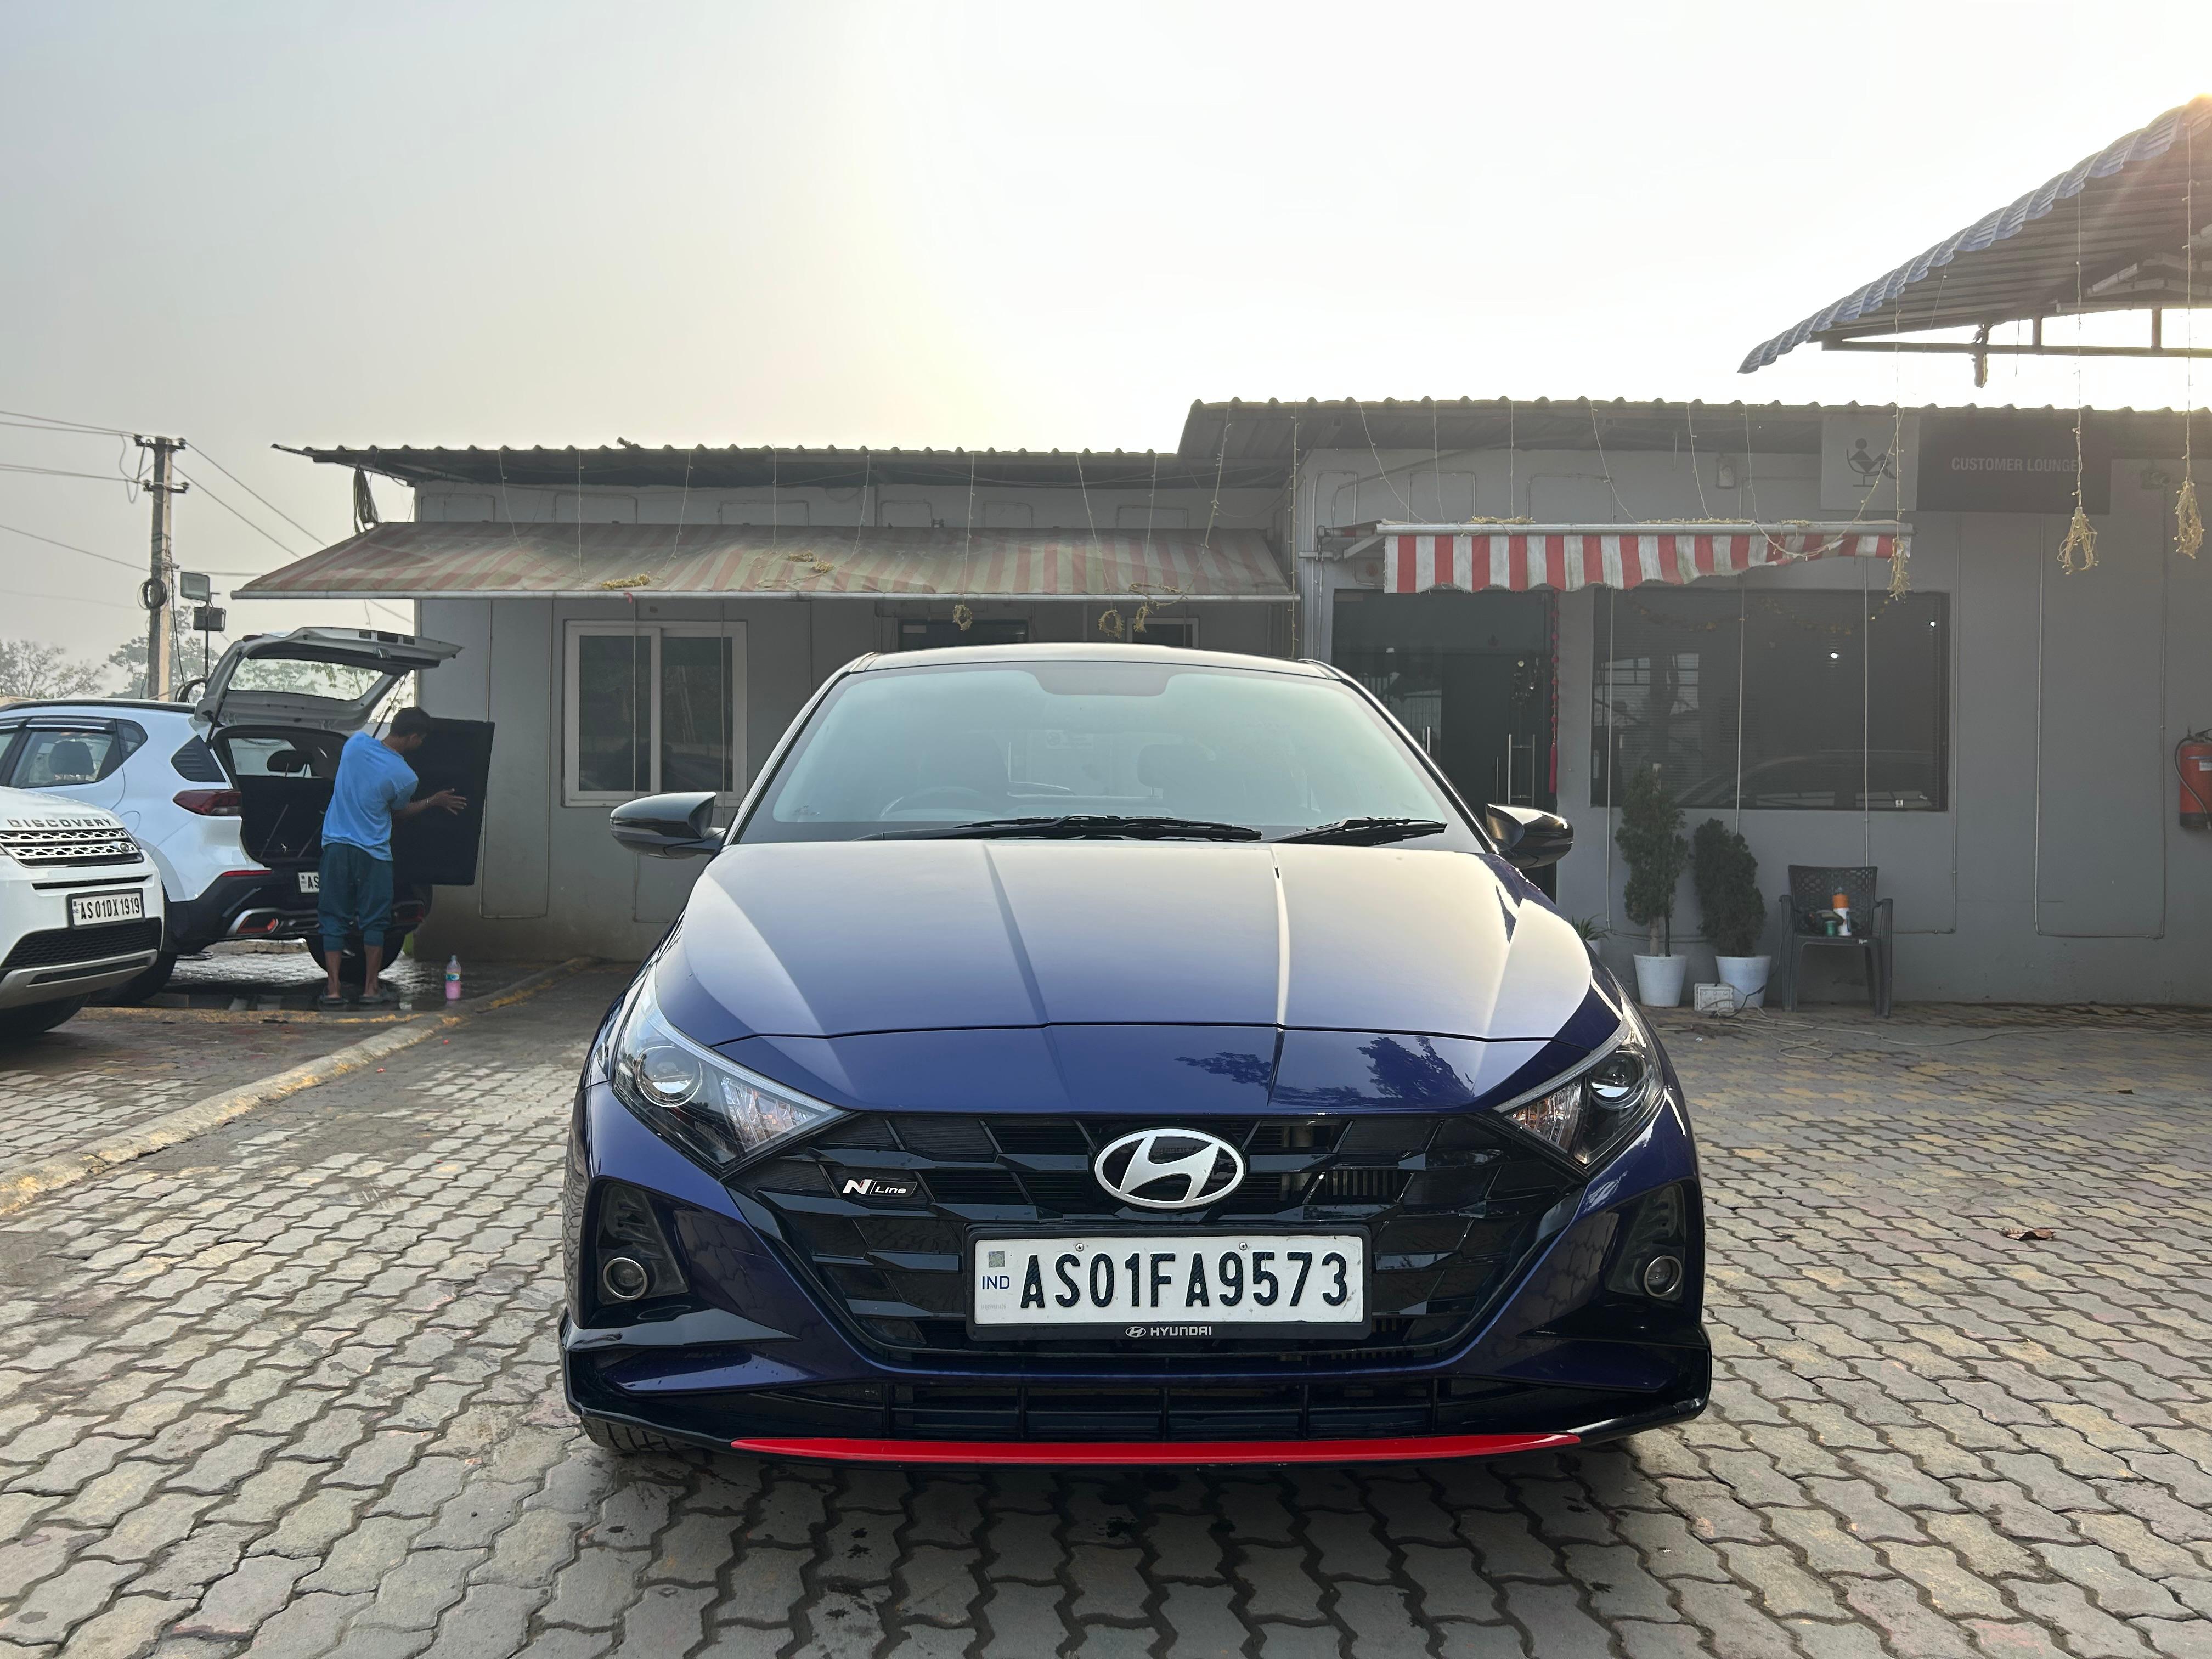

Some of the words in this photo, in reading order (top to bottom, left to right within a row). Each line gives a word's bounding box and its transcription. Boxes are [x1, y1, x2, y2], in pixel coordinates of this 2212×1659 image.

[1951, 456, 2023, 471] CUSTOMER
[2027, 458, 2078, 472] LOUNGE
[7, 818, 112, 828] DISCOVERY
[982, 1276, 1010, 1290] IND
[1020, 1251, 1347, 1308] AS01FA9573
[1150, 1325, 1212, 1336] HYUNDAI
